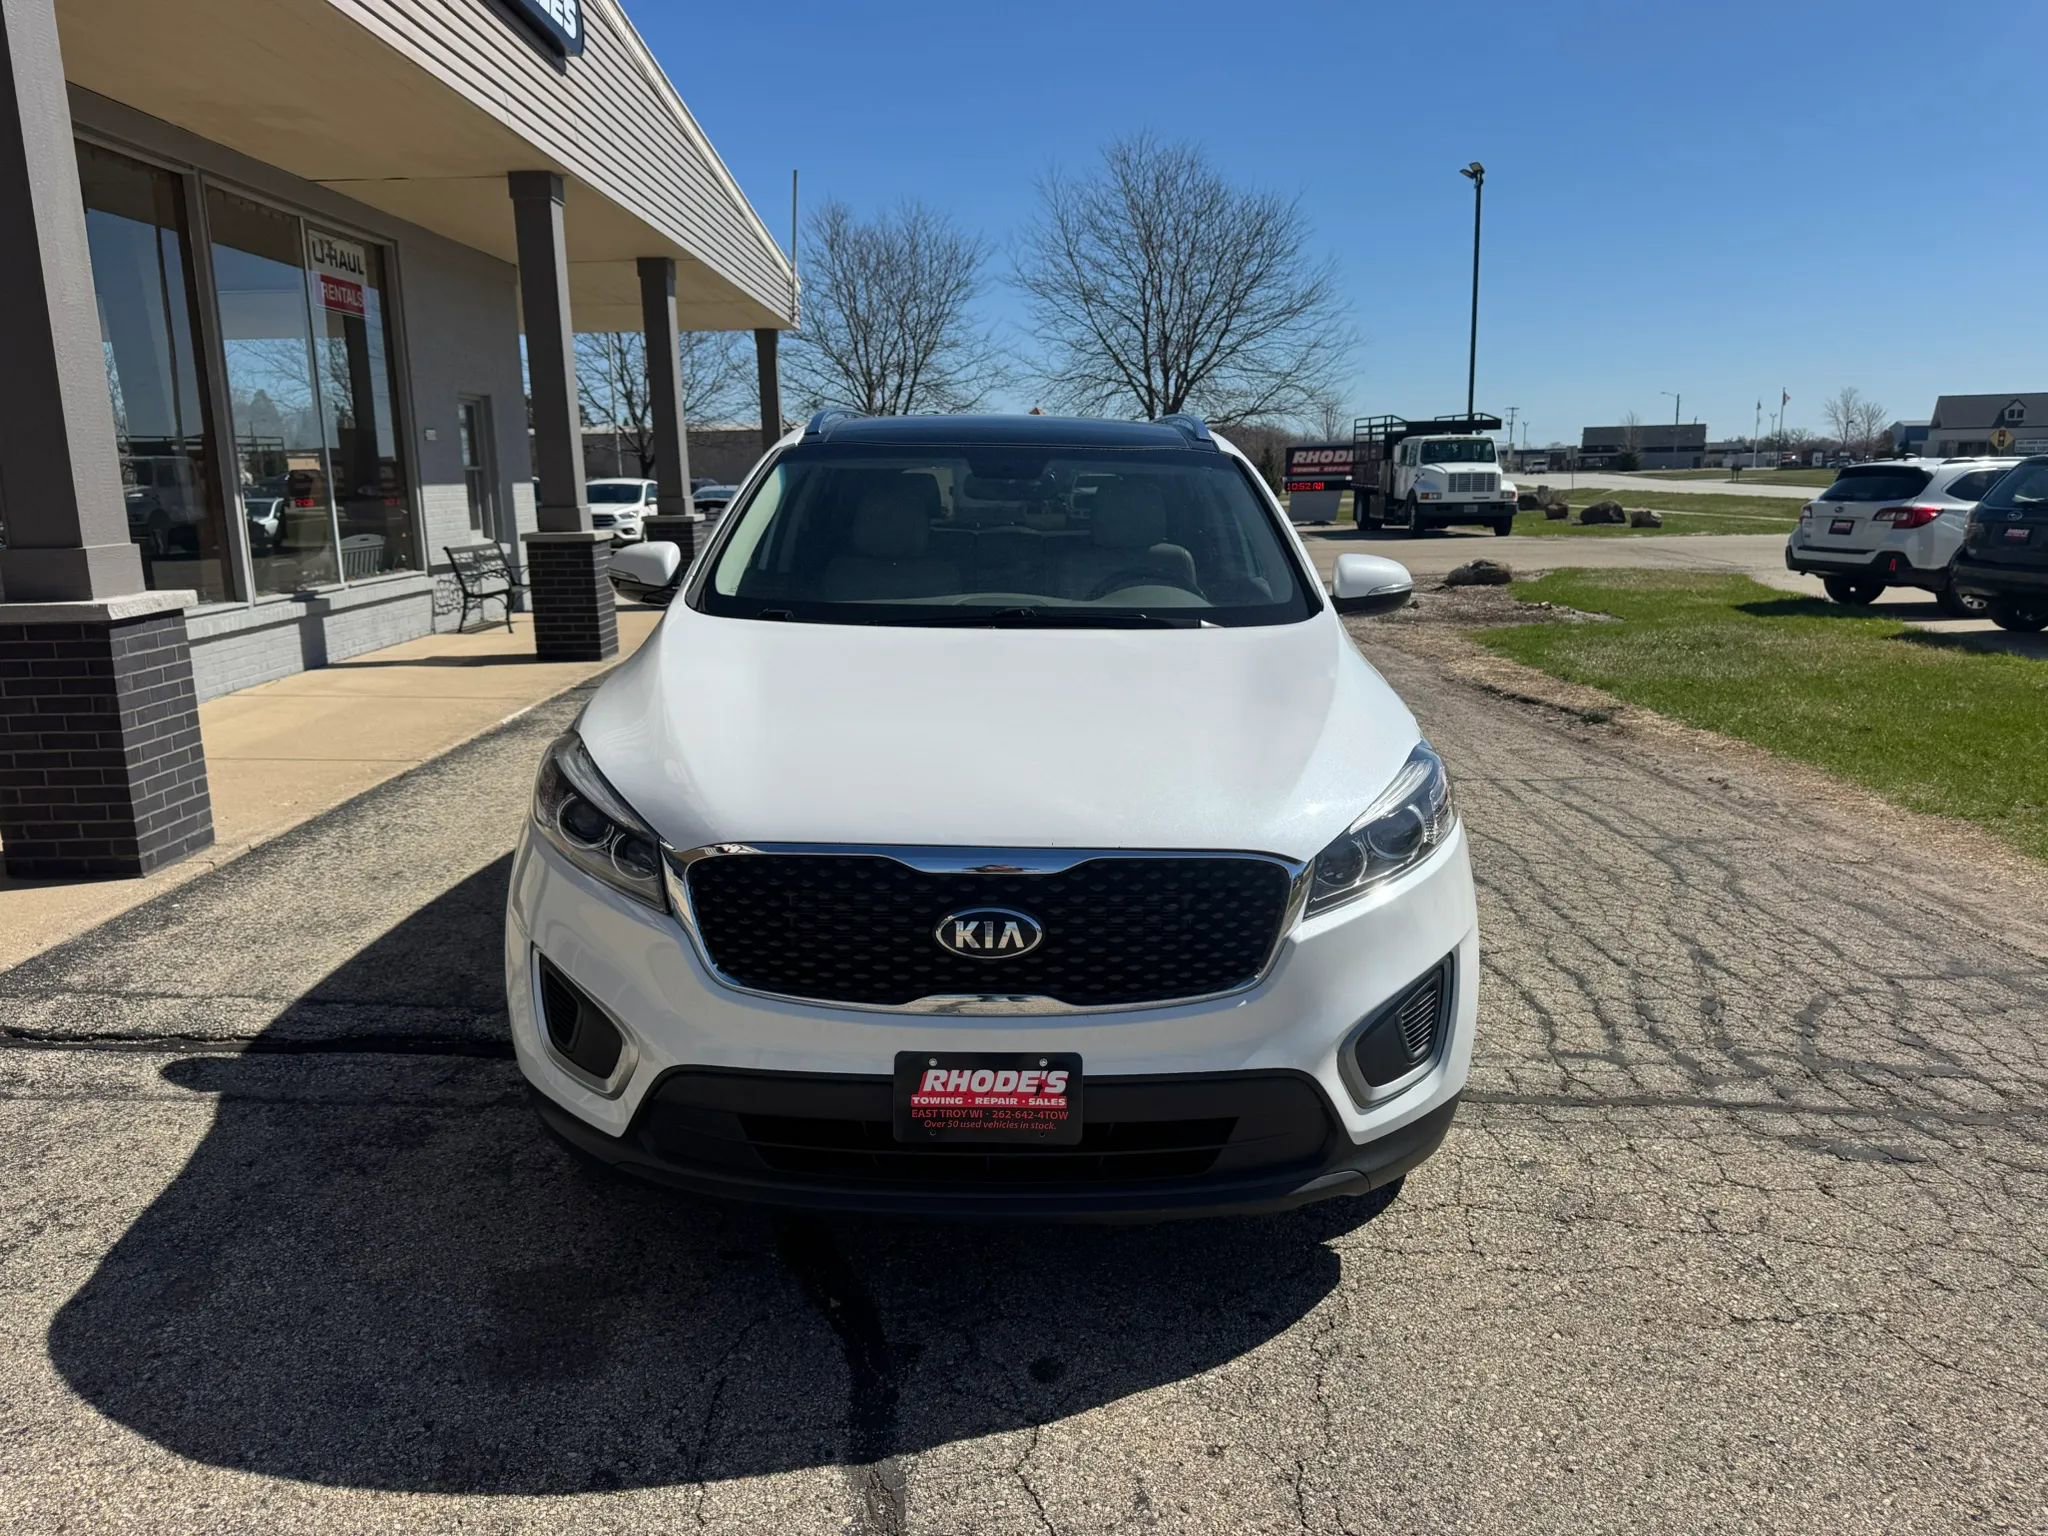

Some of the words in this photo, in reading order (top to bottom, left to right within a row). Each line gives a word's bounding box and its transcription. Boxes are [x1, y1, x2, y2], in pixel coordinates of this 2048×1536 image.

[536, 0, 577, 40] ES
[321, 281, 364, 307] RENTALS
[954, 920, 1025, 949] KIA
[922, 1069, 1070, 1094] RHODE'S
[911, 1096, 964, 1105] TOWING
[974, 1096, 1018, 1105] REPAIR
[1028, 1097, 1067, 1106] SALES
[911, 1109, 938, 1118] EAST
[941, 1109, 969, 1119] TROY
[969, 1109, 984, 1119] WI
[991, 1110, 1070, 1120] 262-642-4TOW
[924, 1120, 946, 1128] Over
[947, 1120, 960, 1128] 50
[960, 1120, 982, 1128] used
[982, 1120, 1020, 1129] vehicles
[1020, 1120, 1030, 1129] in
[1031, 1121, 1057, 1130] stock.
